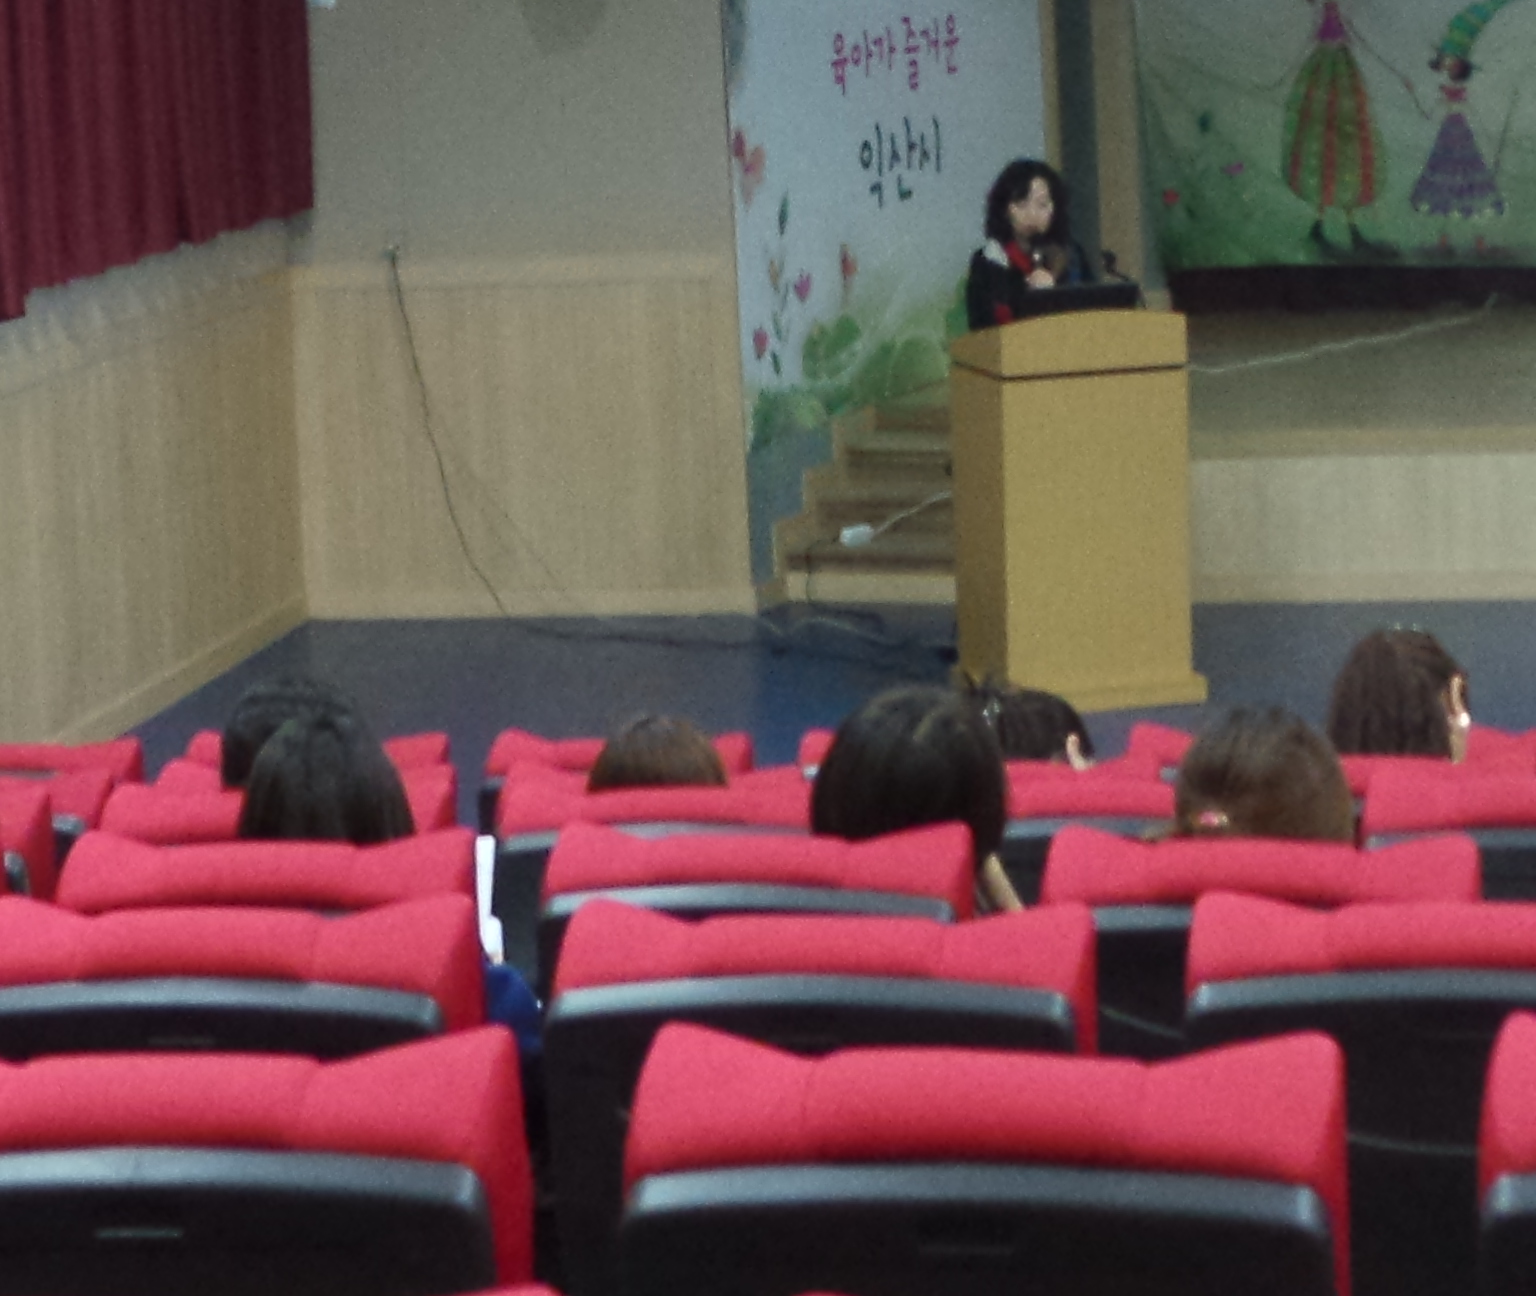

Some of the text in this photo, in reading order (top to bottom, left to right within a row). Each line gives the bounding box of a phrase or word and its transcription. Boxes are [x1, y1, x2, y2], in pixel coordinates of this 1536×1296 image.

[830, 13, 960, 97] 육아가 즐거운
[859, 114, 942, 210] 익산시
